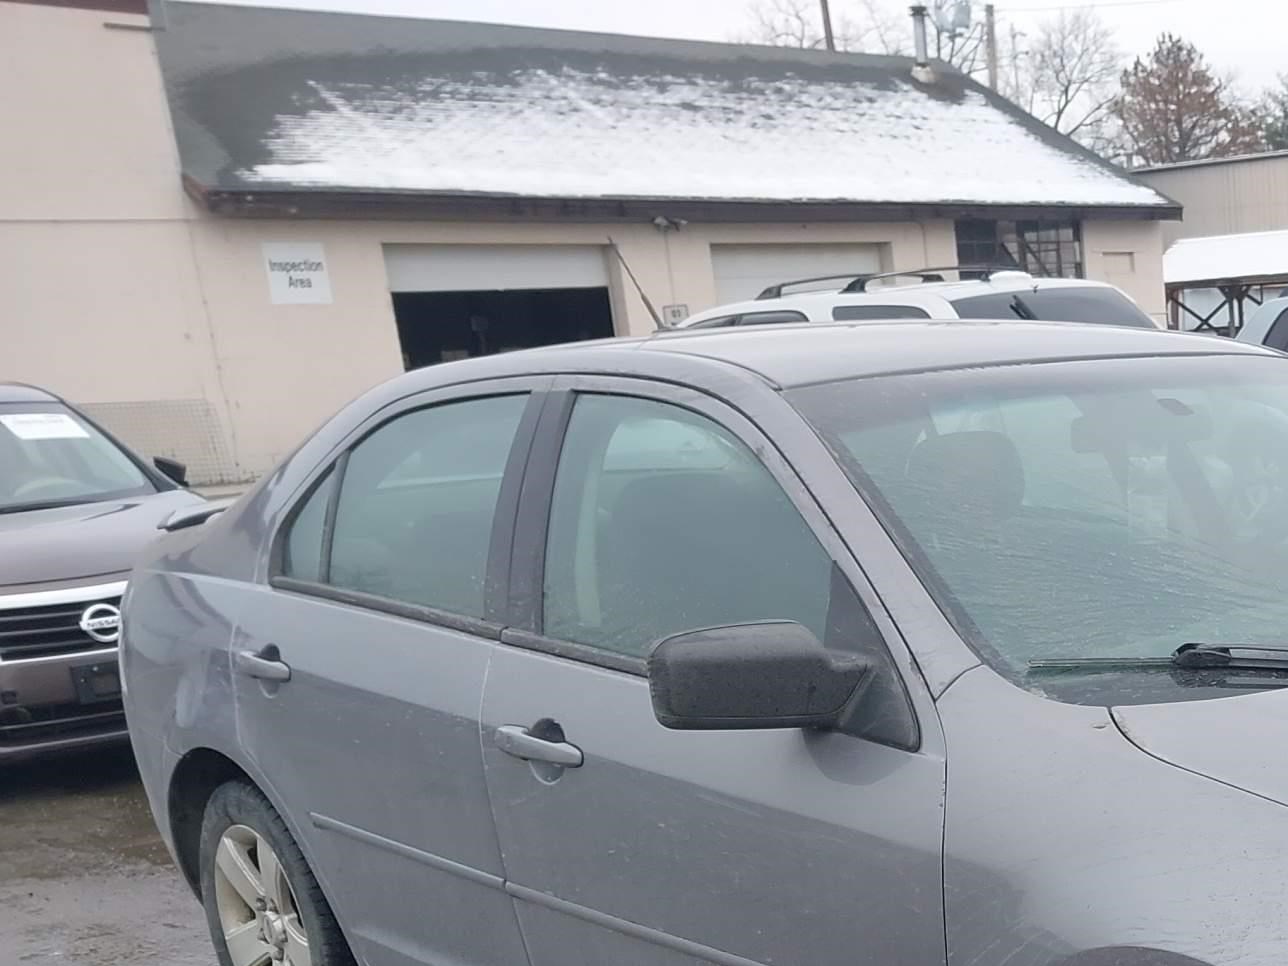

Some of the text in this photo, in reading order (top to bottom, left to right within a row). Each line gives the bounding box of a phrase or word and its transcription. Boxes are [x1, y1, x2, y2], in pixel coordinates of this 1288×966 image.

[268, 258, 324, 273] Inspection
[288, 275, 312, 289] Area
[86, 618, 119, 628] NISSA
